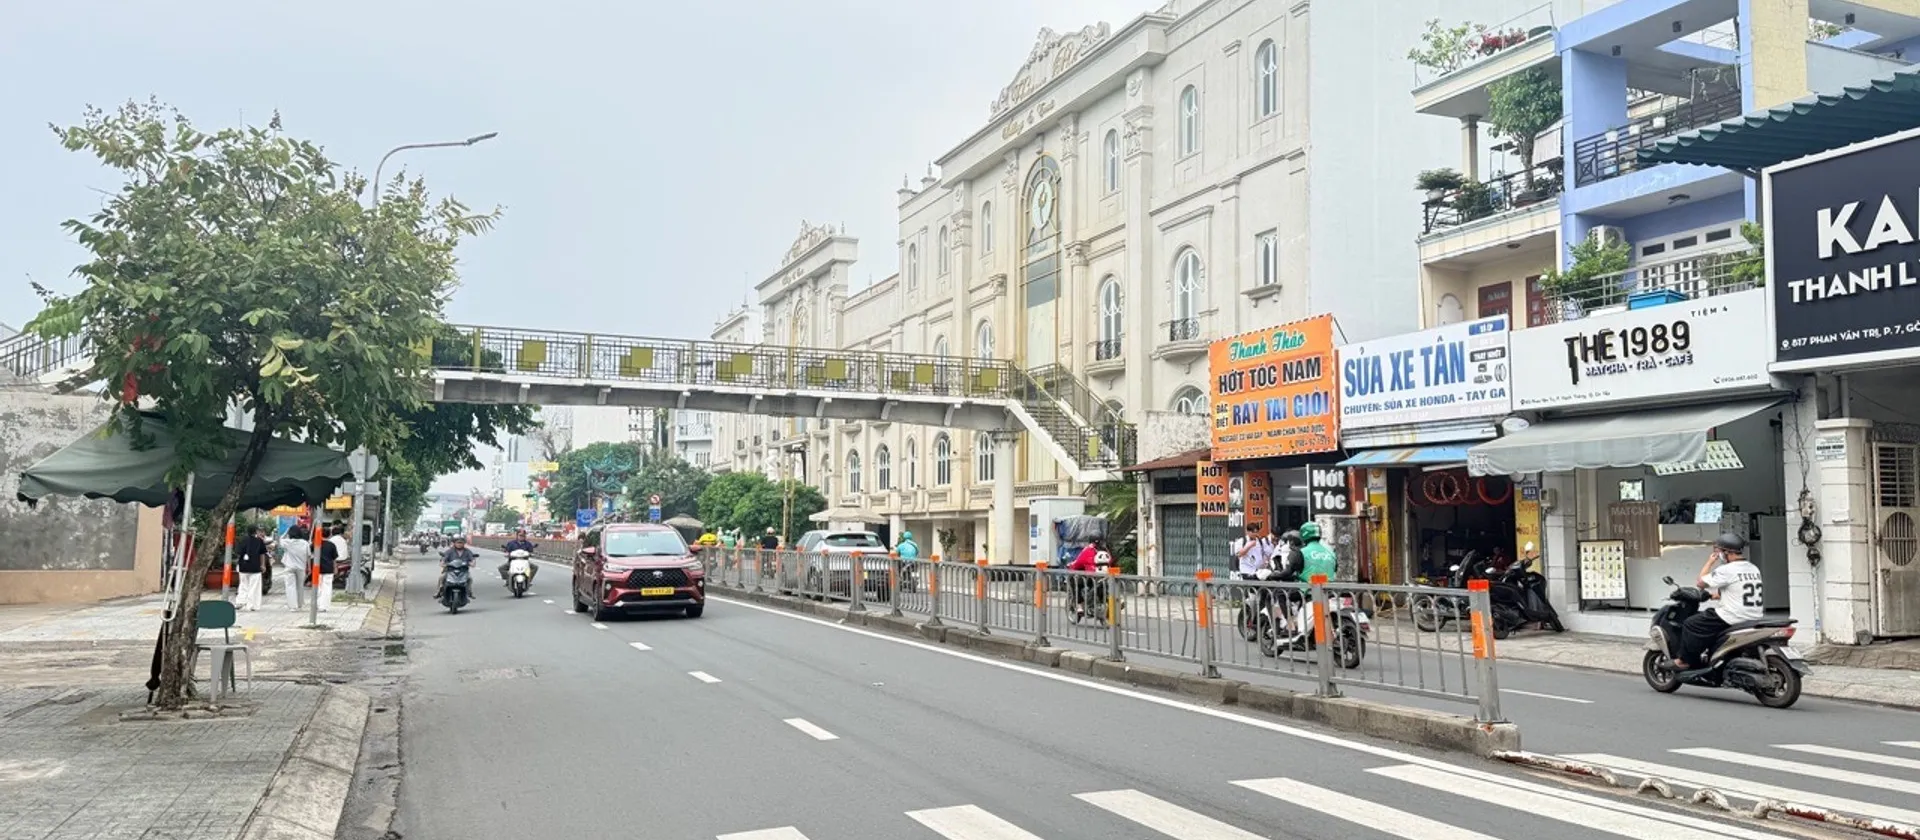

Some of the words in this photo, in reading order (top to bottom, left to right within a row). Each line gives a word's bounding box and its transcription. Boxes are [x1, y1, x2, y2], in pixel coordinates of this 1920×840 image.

[1816, 187, 1920, 259] KA
[1787, 264, 1893, 303] THANH
[1898, 258, 1920, 286] L
[1792, 338, 1807, 347] 817
[1810, 333, 1838, 345] PHAN
[1840, 329, 1860, 341] VĂN
[1884, 326, 1893, 336] P.
[1229, 338, 1267, 361] Thanh
[1564, 328, 1616, 385] THE
[1619, 320, 1690, 358] 1989
[1218, 369, 1245, 394] HỚT
[1249, 363, 1277, 389] TÓC
[1282, 356, 1321, 383] NAM
[1344, 346, 1384, 398] SỬA
[1389, 349, 1415, 392] XE
[1420, 335, 1466, 388] TÂN
[1585, 362, 1628, 377] MATCHA
[1265, 397, 1287, 421] TAI
[1405, 397, 1418, 408] XE
[1419, 393, 1456, 407] HONDA
[1466, 390, 1486, 401] TAY
[1489, 387, 1506, 399] GA
[1312, 468, 1346, 487] Hớt
[1201, 501, 1226, 513] NAM
[1312, 490, 1347, 510] Tóc
[1611, 506, 1653, 516] MATCHA
[1743, 583, 1763, 607] 23
